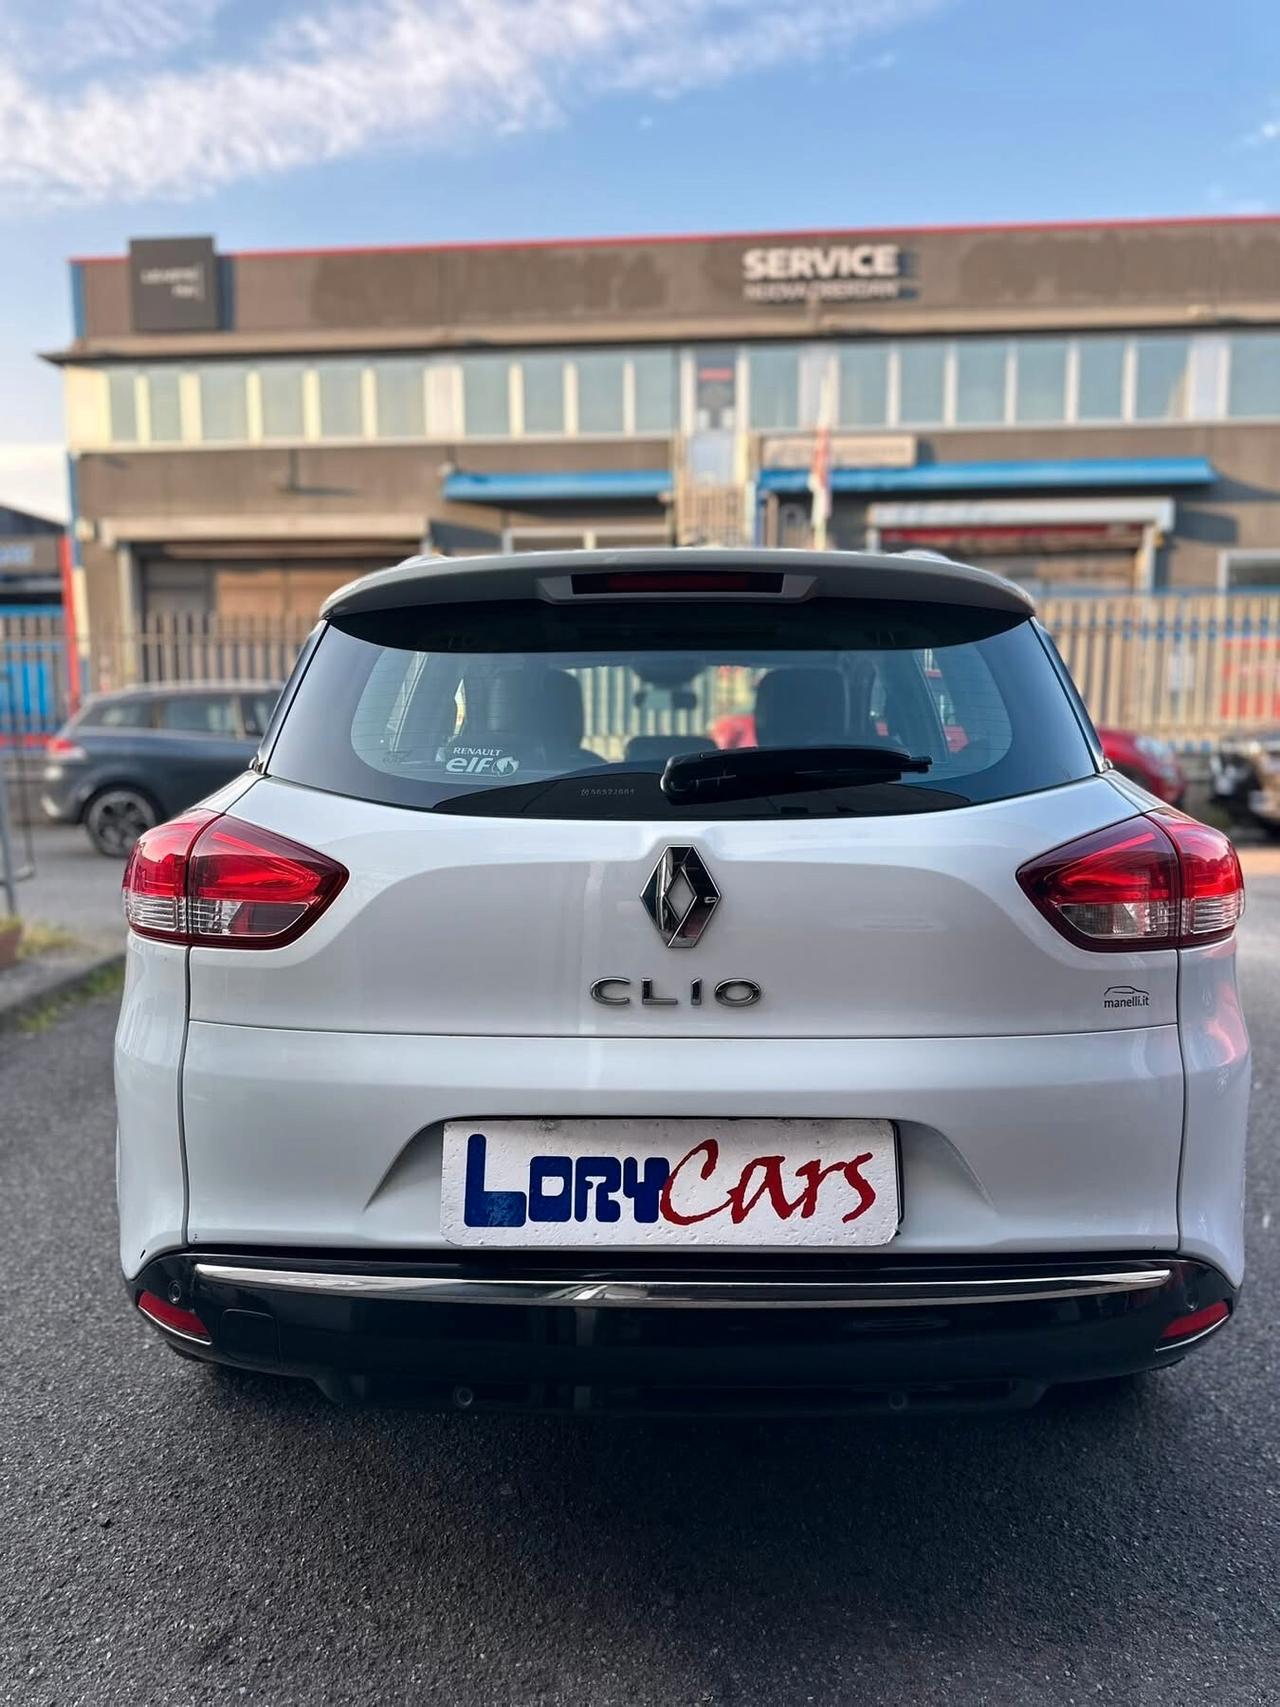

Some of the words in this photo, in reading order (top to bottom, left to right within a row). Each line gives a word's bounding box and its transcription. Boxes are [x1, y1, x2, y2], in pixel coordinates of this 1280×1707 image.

[742, 244, 899, 280] SERVICE
[452, 747, 502, 757] RENAULT
[590, 976, 762, 1008] CLIO
[1104, 995, 1149, 1008] manelli.it
